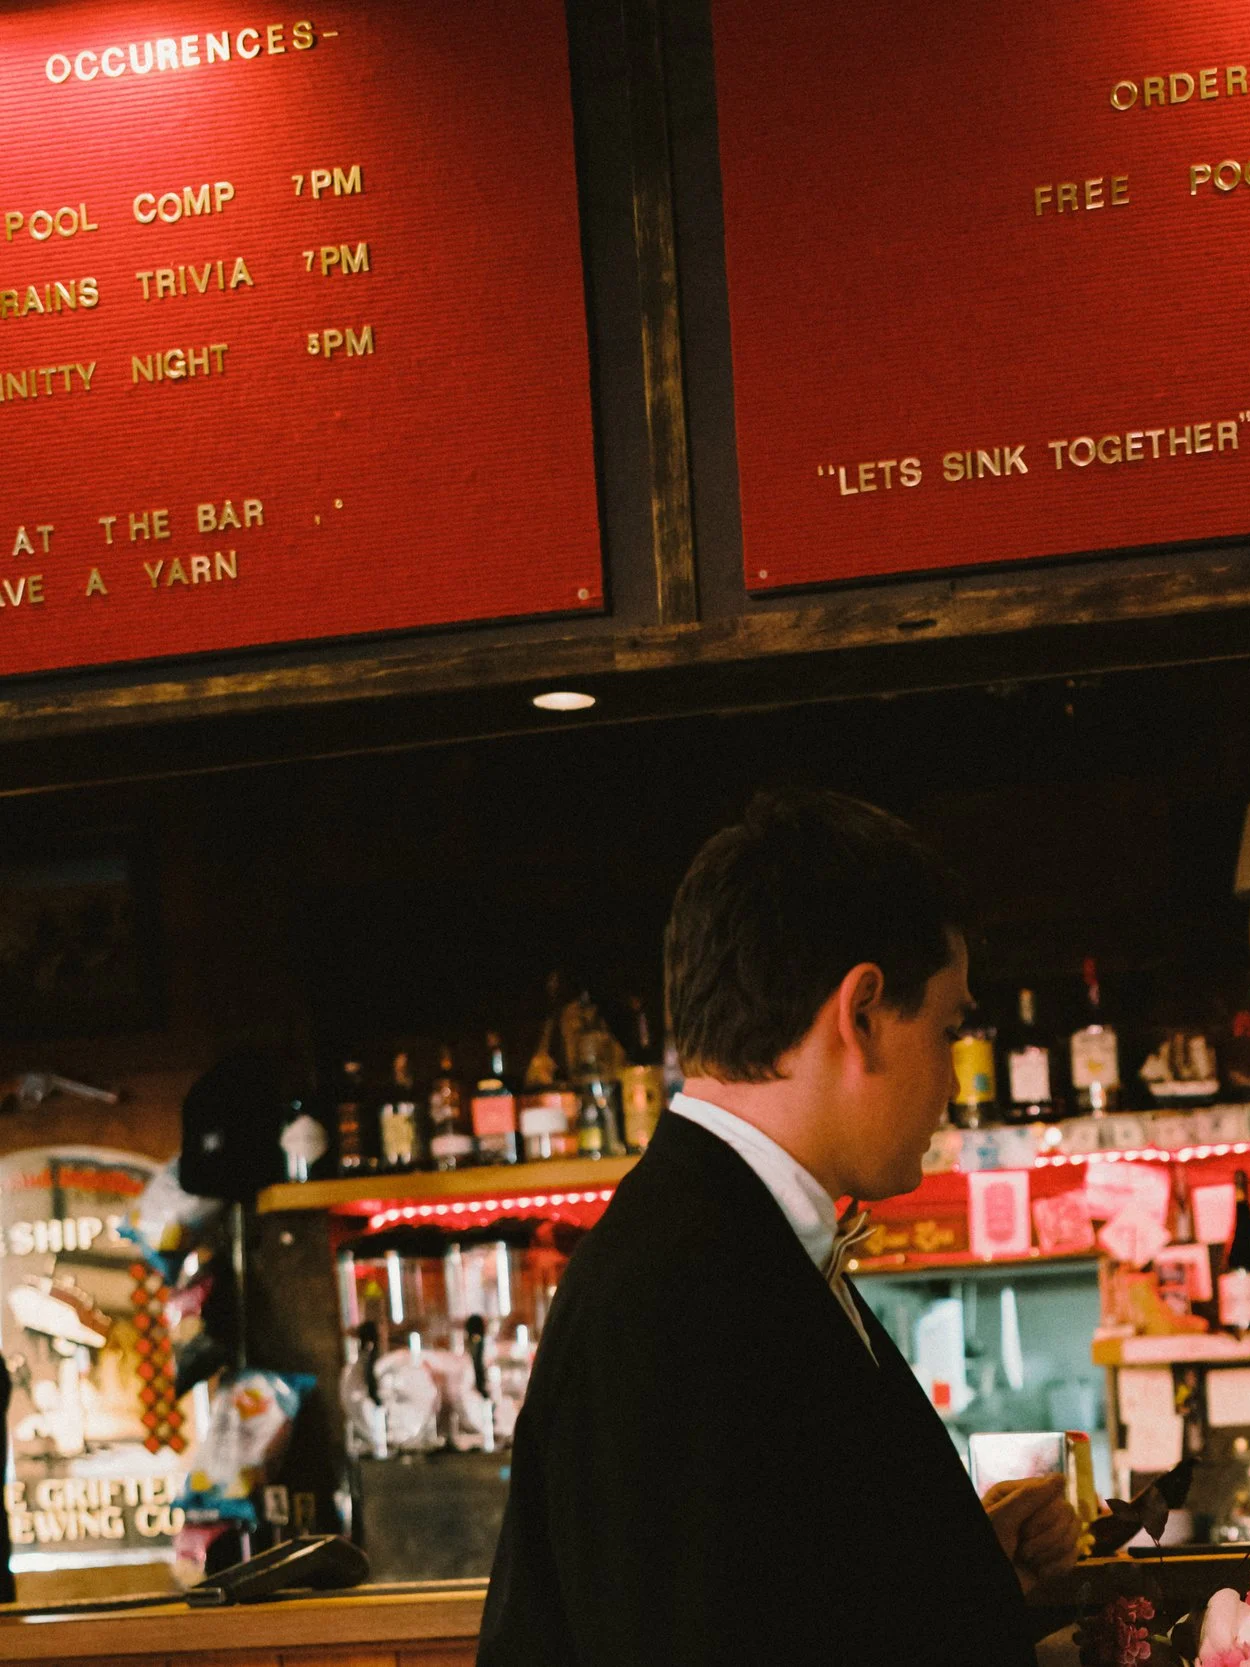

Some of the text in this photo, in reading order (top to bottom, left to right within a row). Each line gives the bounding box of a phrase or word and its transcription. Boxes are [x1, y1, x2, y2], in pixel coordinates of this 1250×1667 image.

[45, 20, 339, 84] OCCURENCES-
[1109, 65, 1248, 111] ORDER
[5, 165, 362, 241] POOL COMP 7PM
[1034, 175, 1130, 216] FREE
[136, 257, 253, 300] TRIVIA
[302, 242, 370, 276] 7PM
[131, 344, 228, 383] NIGHT
[307, 325, 374, 358] 5PM
[942, 445, 1029, 482] SINK
[12, 499, 264, 554] AT THE BAR
[85, 568, 108, 597] A
[144, 550, 237, 588] YARN
[10, 1216, 102, 1255] SHIP
[135, 1503, 186, 1537] CO
